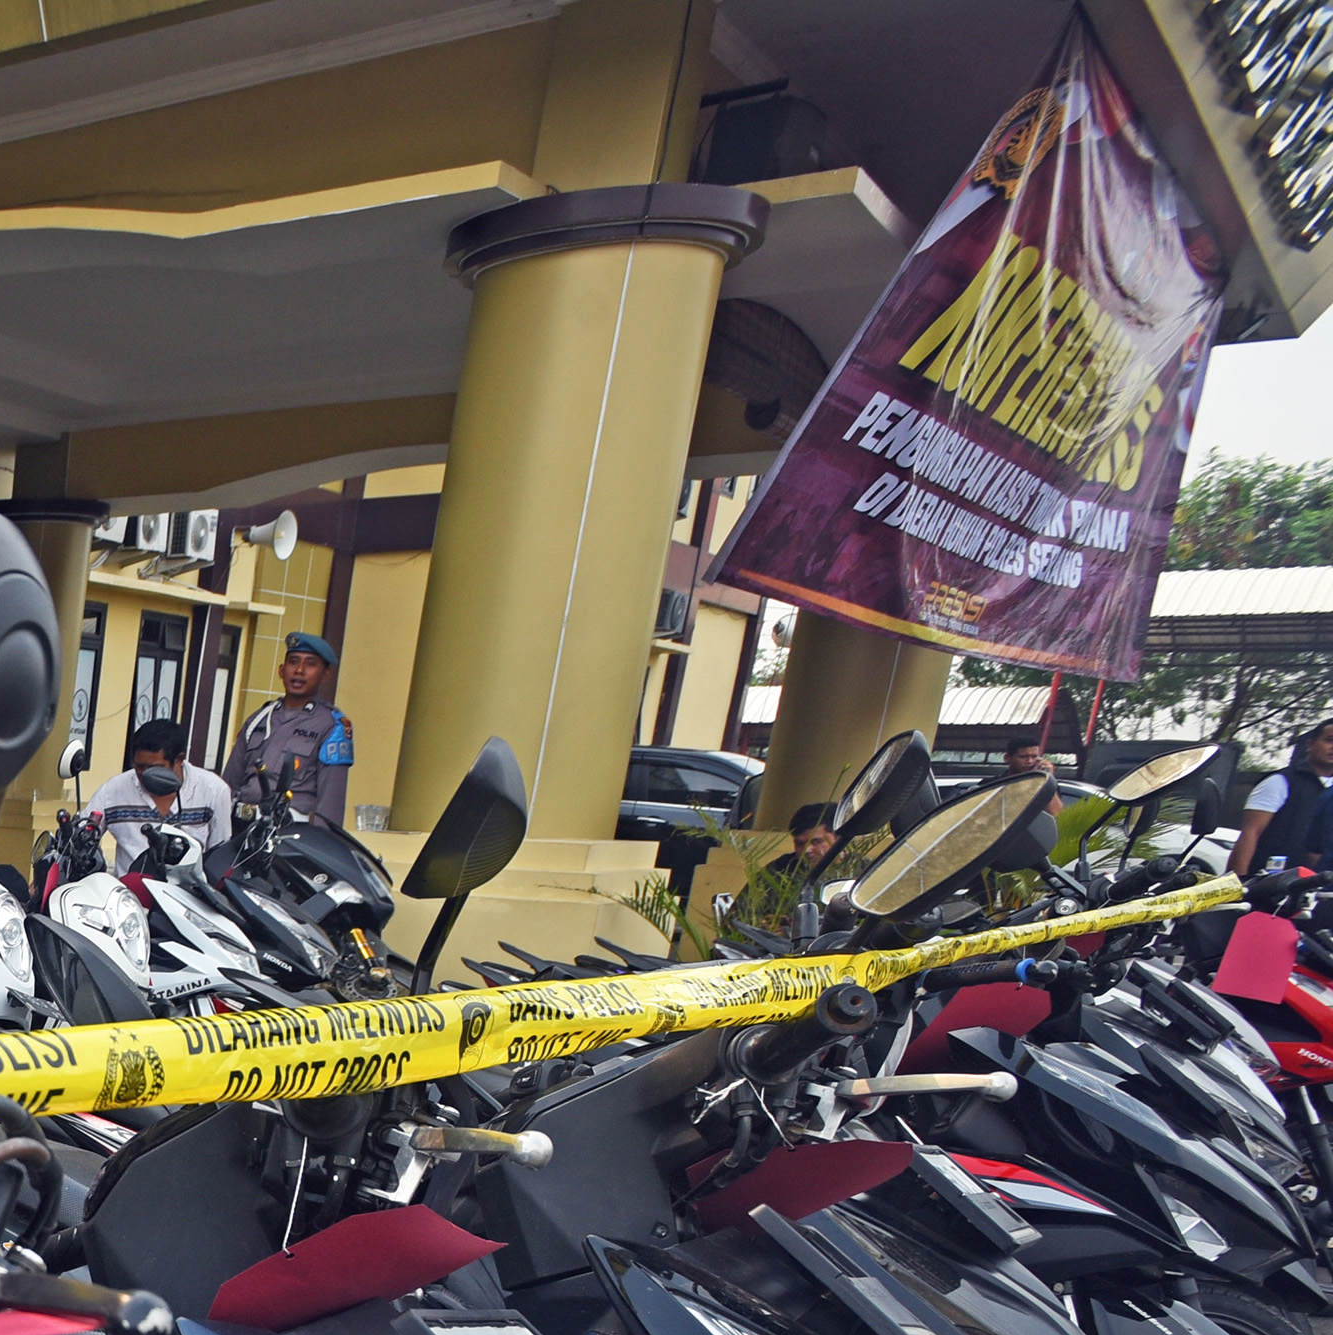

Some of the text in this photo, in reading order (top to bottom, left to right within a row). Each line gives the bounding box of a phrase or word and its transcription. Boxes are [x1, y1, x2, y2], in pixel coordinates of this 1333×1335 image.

[853, 472, 901, 518] DI
[1028, 542, 1083, 588] SERANG
[293, 728, 319, 739] POLRI
[263, 952, 293, 973] HONDA
[175, 996, 446, 1055] DILARANG MELINTAS
[498, 983, 575, 1023] GARIS
[219, 1050, 411, 1101] DO NOT CROSS
